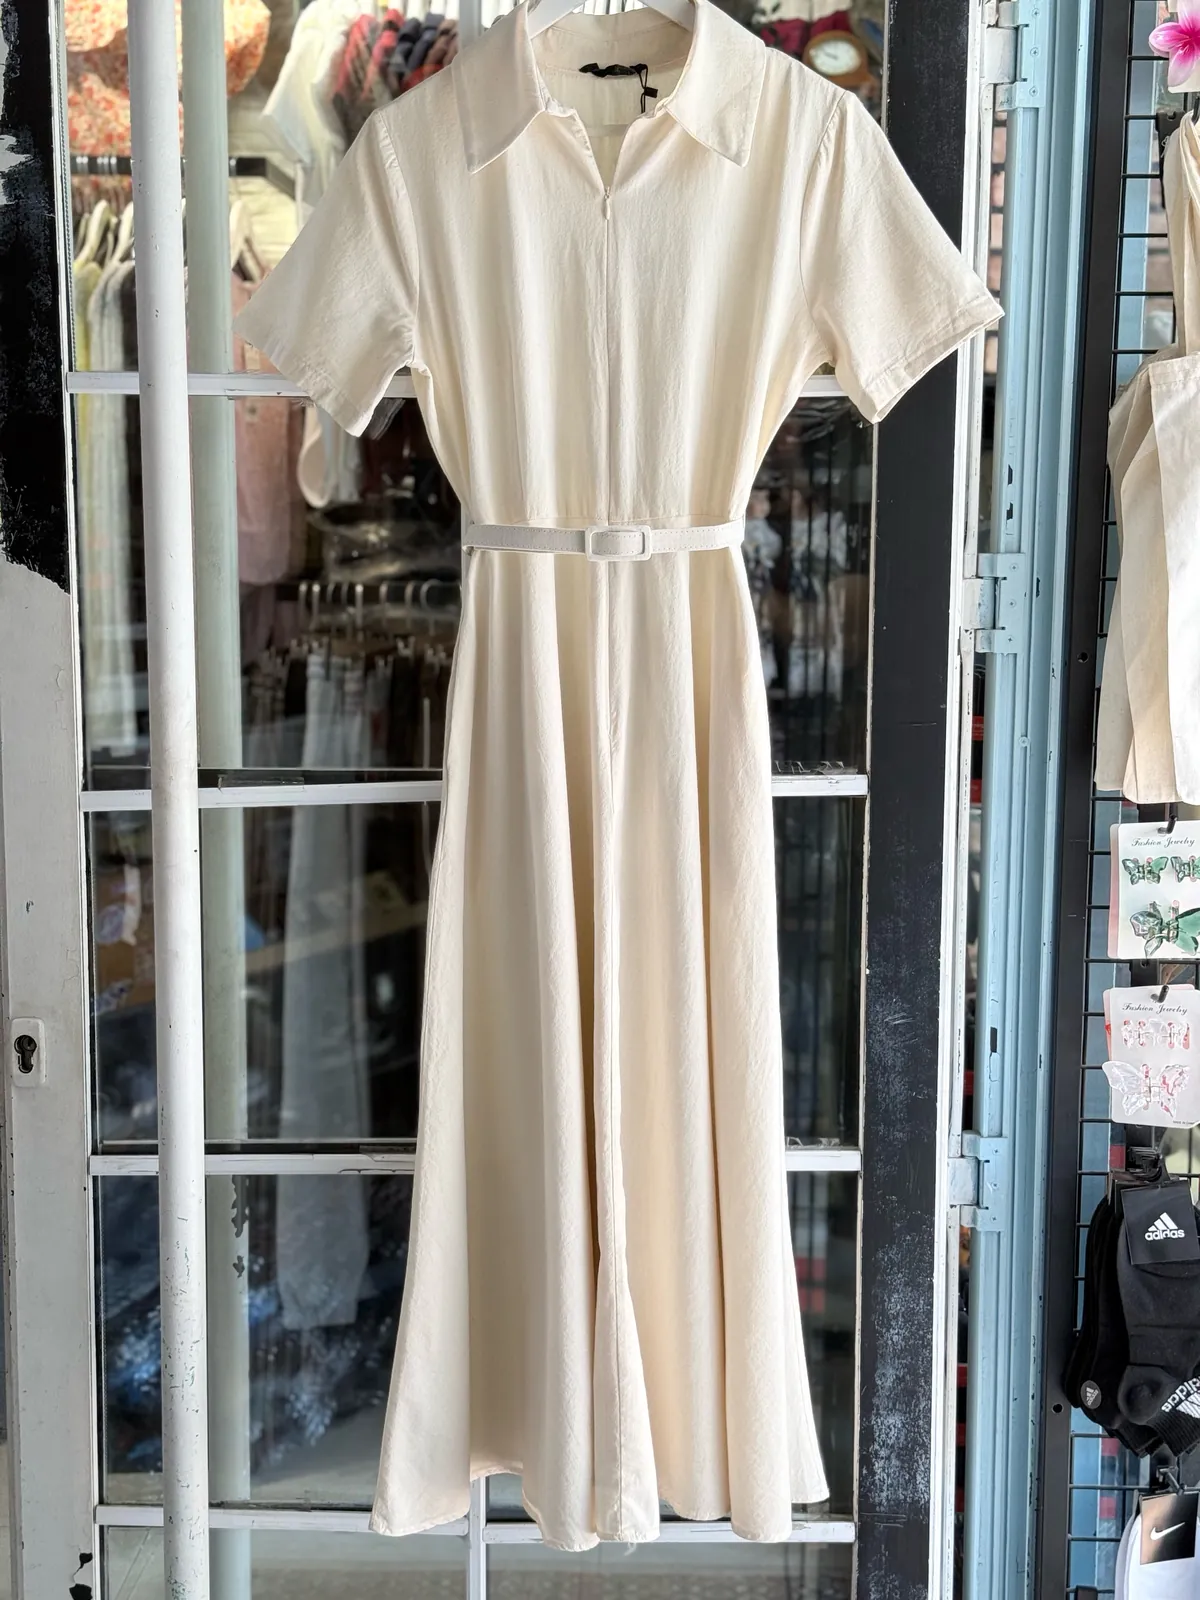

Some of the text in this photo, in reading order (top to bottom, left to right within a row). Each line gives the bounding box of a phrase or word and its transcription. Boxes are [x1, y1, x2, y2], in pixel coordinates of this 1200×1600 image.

[1131, 837, 1195, 848] Fashion Jewelry
[1122, 1002, 1188, 1016] Fashion Jewelry
[1145, 1229, 1185, 1241] adidas
[1161, 1376, 1200, 1412] didas
